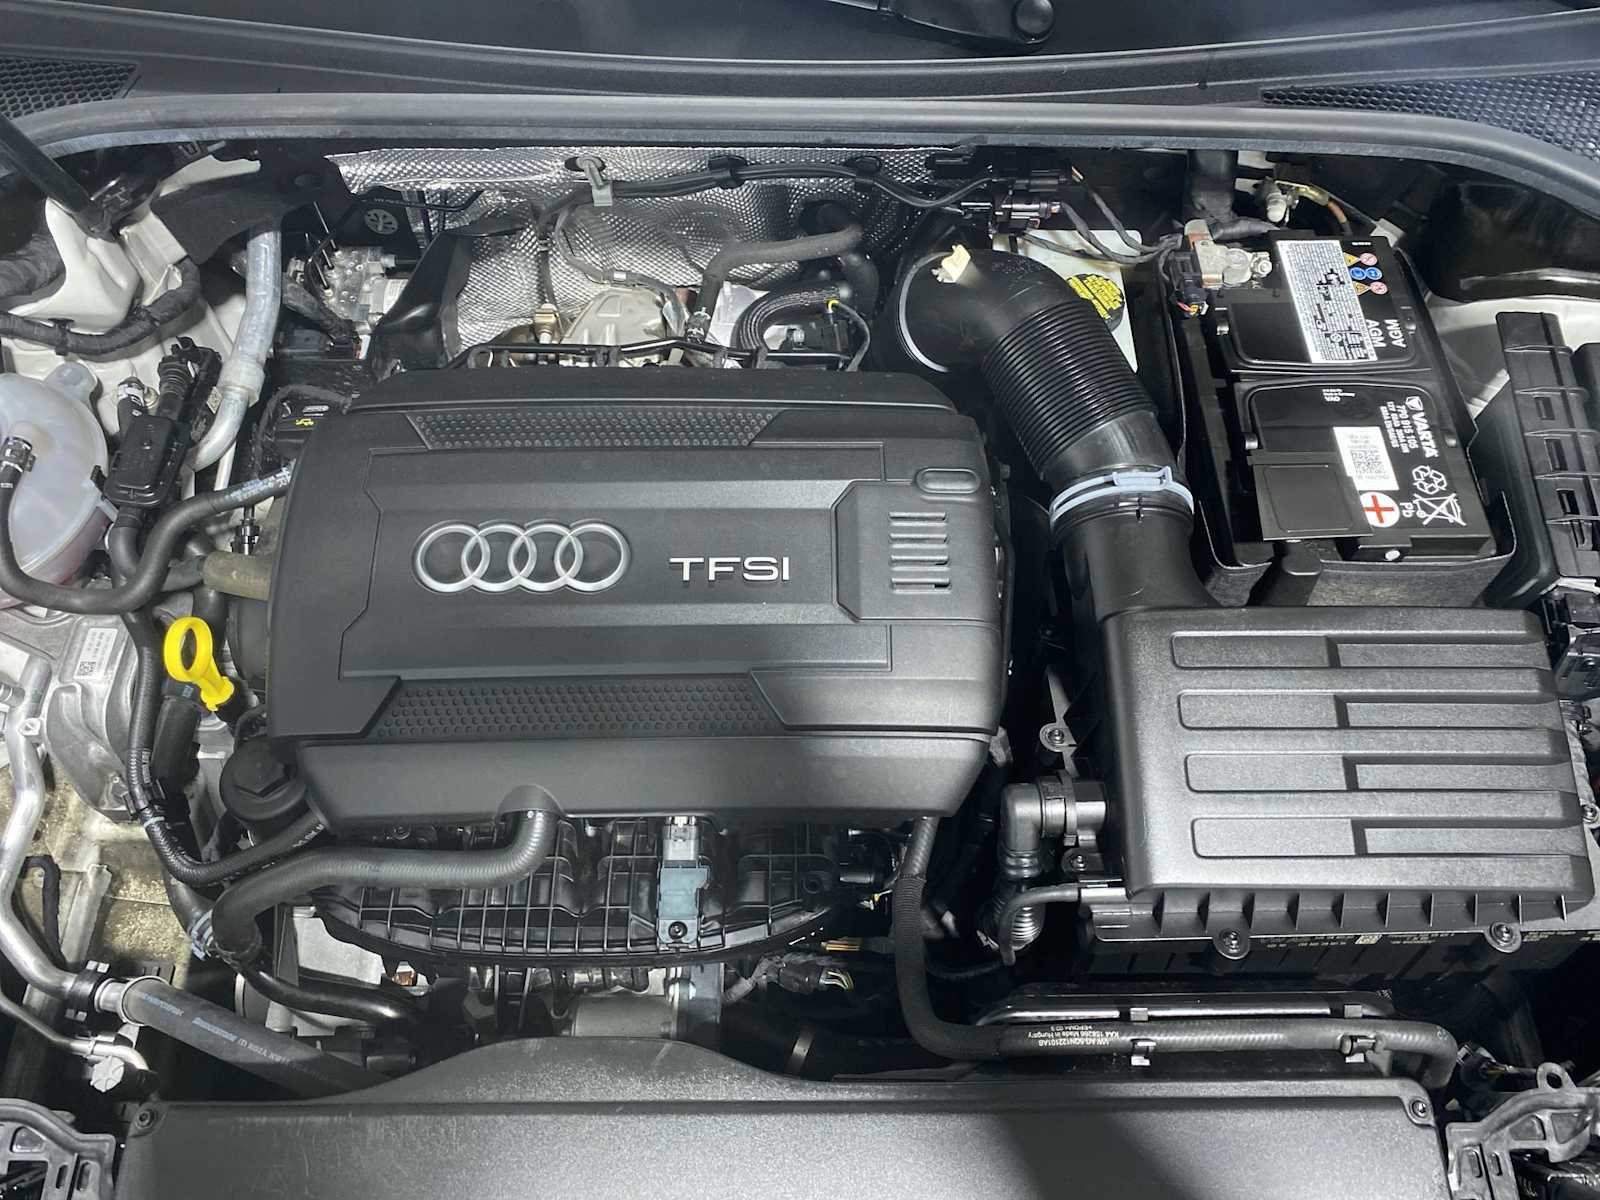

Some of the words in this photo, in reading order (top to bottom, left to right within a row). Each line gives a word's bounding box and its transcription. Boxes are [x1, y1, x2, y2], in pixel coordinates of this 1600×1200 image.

[1365, 319, 1387, 347] AGM
[1384, 319, 1407, 348] AGM
[1412, 412, 1439, 458] VARTA
[1400, 502, 1415, 518] Pb
[669, 556, 790, 581] TFSI
[1028, 1031, 1054, 1039] Hungary
